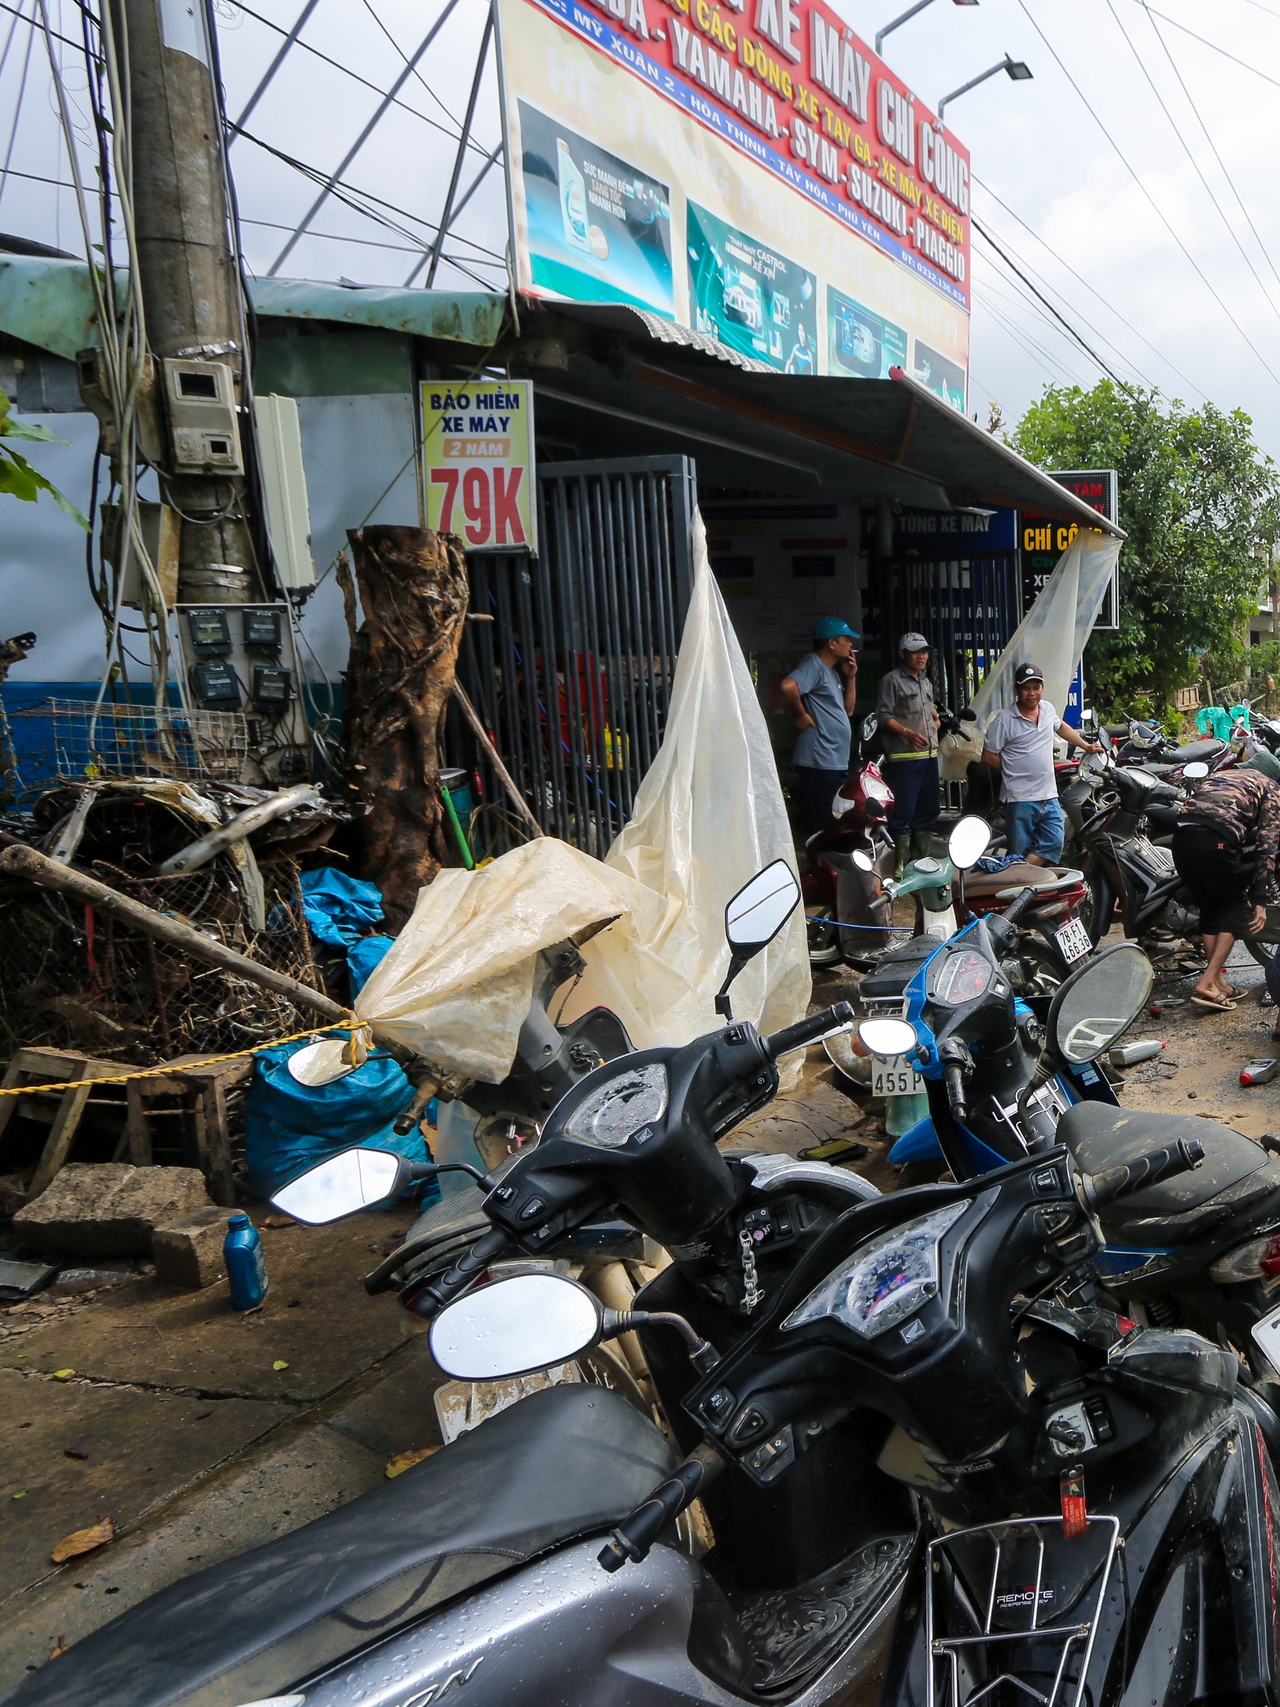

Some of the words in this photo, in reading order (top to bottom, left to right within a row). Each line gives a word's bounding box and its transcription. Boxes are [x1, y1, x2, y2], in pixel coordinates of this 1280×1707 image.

[573, 7, 603, 38] MỸ
[610, 34, 659, 80] XUÂN
[664, 76, 675, 93] 2
[690, 95, 721, 126] HÒA
[725, 119, 767, 158] THỊNH
[777, 158, 802, 184] TÂY
[805, 179, 829, 204] HÒA
[837, 203, 858, 225] PHÚ
[861, 220, 880, 241] YÊN
[696, 0, 737, 52] CÁC
[743, 36, 793, 100] DÒNG
[798, 85, 820, 122] XE
[824, 106, 851, 148] TAY
[854, 134, 872, 167] GA
[881, 156, 896, 187] XE
[900, 171, 922, 208] MÁY
[925, 195, 939, 223] XE
[941, 209, 963, 246] ĐIỆN
[812, 10, 870, 123] MÁY
[880, 80, 916, 166] CHÍ
[920, 121, 968, 215] CÔNG
[672, 17, 779, 139] YAMAHA
[794, 118, 839, 184] SYM
[851, 163, 907, 237] SUZUKI
[916, 217, 966, 282] PIAGGIO
[588, 190, 612, 214] NHANH
[756, 248, 788, 274] CASTROL
[430, 388, 471, 411] BẢO
[476, 385, 520, 410] HIỂM
[441, 416, 464, 433] XE
[469, 413, 510, 433] MÁY
[449, 440, 462, 456] 2
[466, 440, 503, 456] NĂM
[1072, 480, 1103, 497] TÂM
[430, 466, 526, 545] 79K
[900, 512, 937, 533] TÙNG
[940, 516, 958, 532] XE
[1024, 523, 1052, 551] CHÍ
[1059, 922, 1082, 946] 78-F1
[1064, 934, 1091, 961] 466.36
